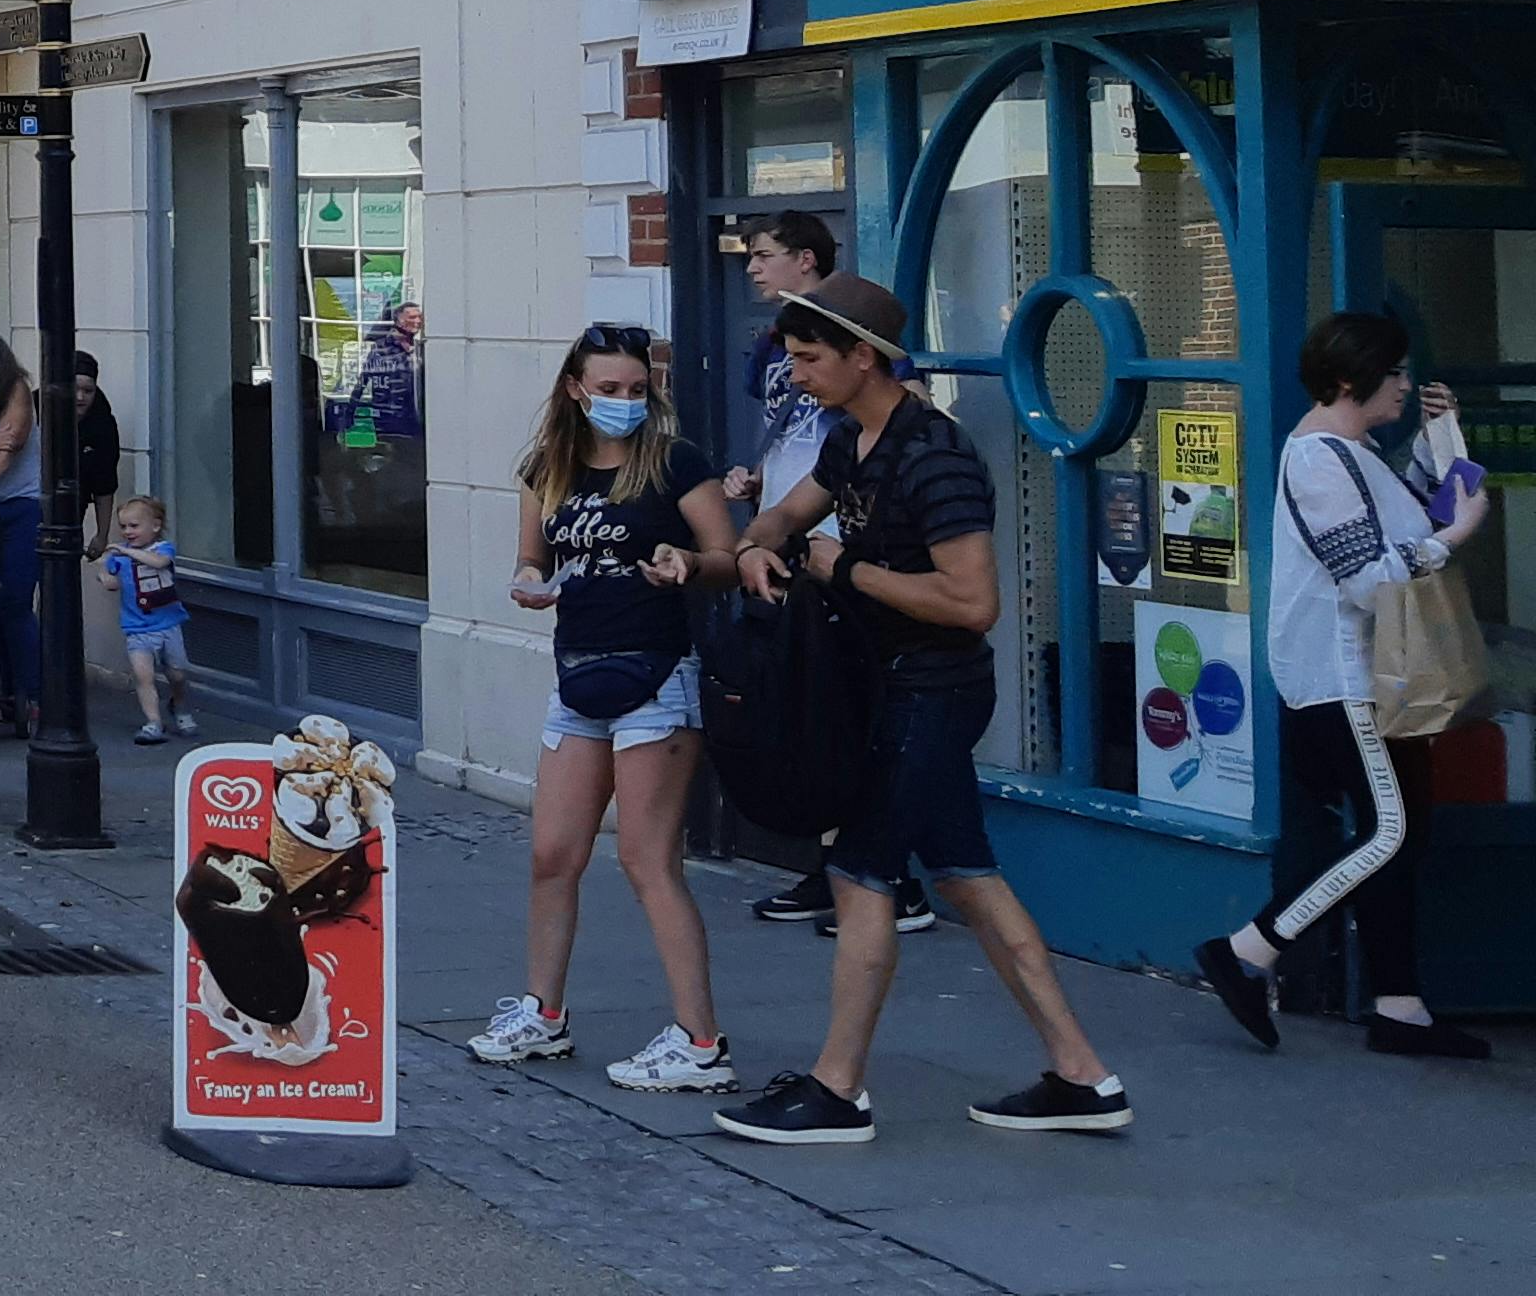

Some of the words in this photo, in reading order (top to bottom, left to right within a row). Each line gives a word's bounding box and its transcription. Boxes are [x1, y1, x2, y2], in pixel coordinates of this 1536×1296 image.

[6, 119, 18, 130] &
[1175, 422, 1219, 449] CCTV
[1175, 447, 1220, 466] SYSTEM
[542, 511, 630, 548] Coffee
[1356, 720, 1381, 754] LUXE
[1374, 766, 1394, 799] LUXE
[205, 814, 259, 830] WALL'S
[1322, 869, 1353, 897] LUXE
[1290, 899, 1318, 926] LUXE
[204, 1081, 252, 1104] Fancy
[256, 1086, 274, 1098] an
[280, 1082, 303, 1098] Ice
[308, 1081, 365, 1099] Cream?
